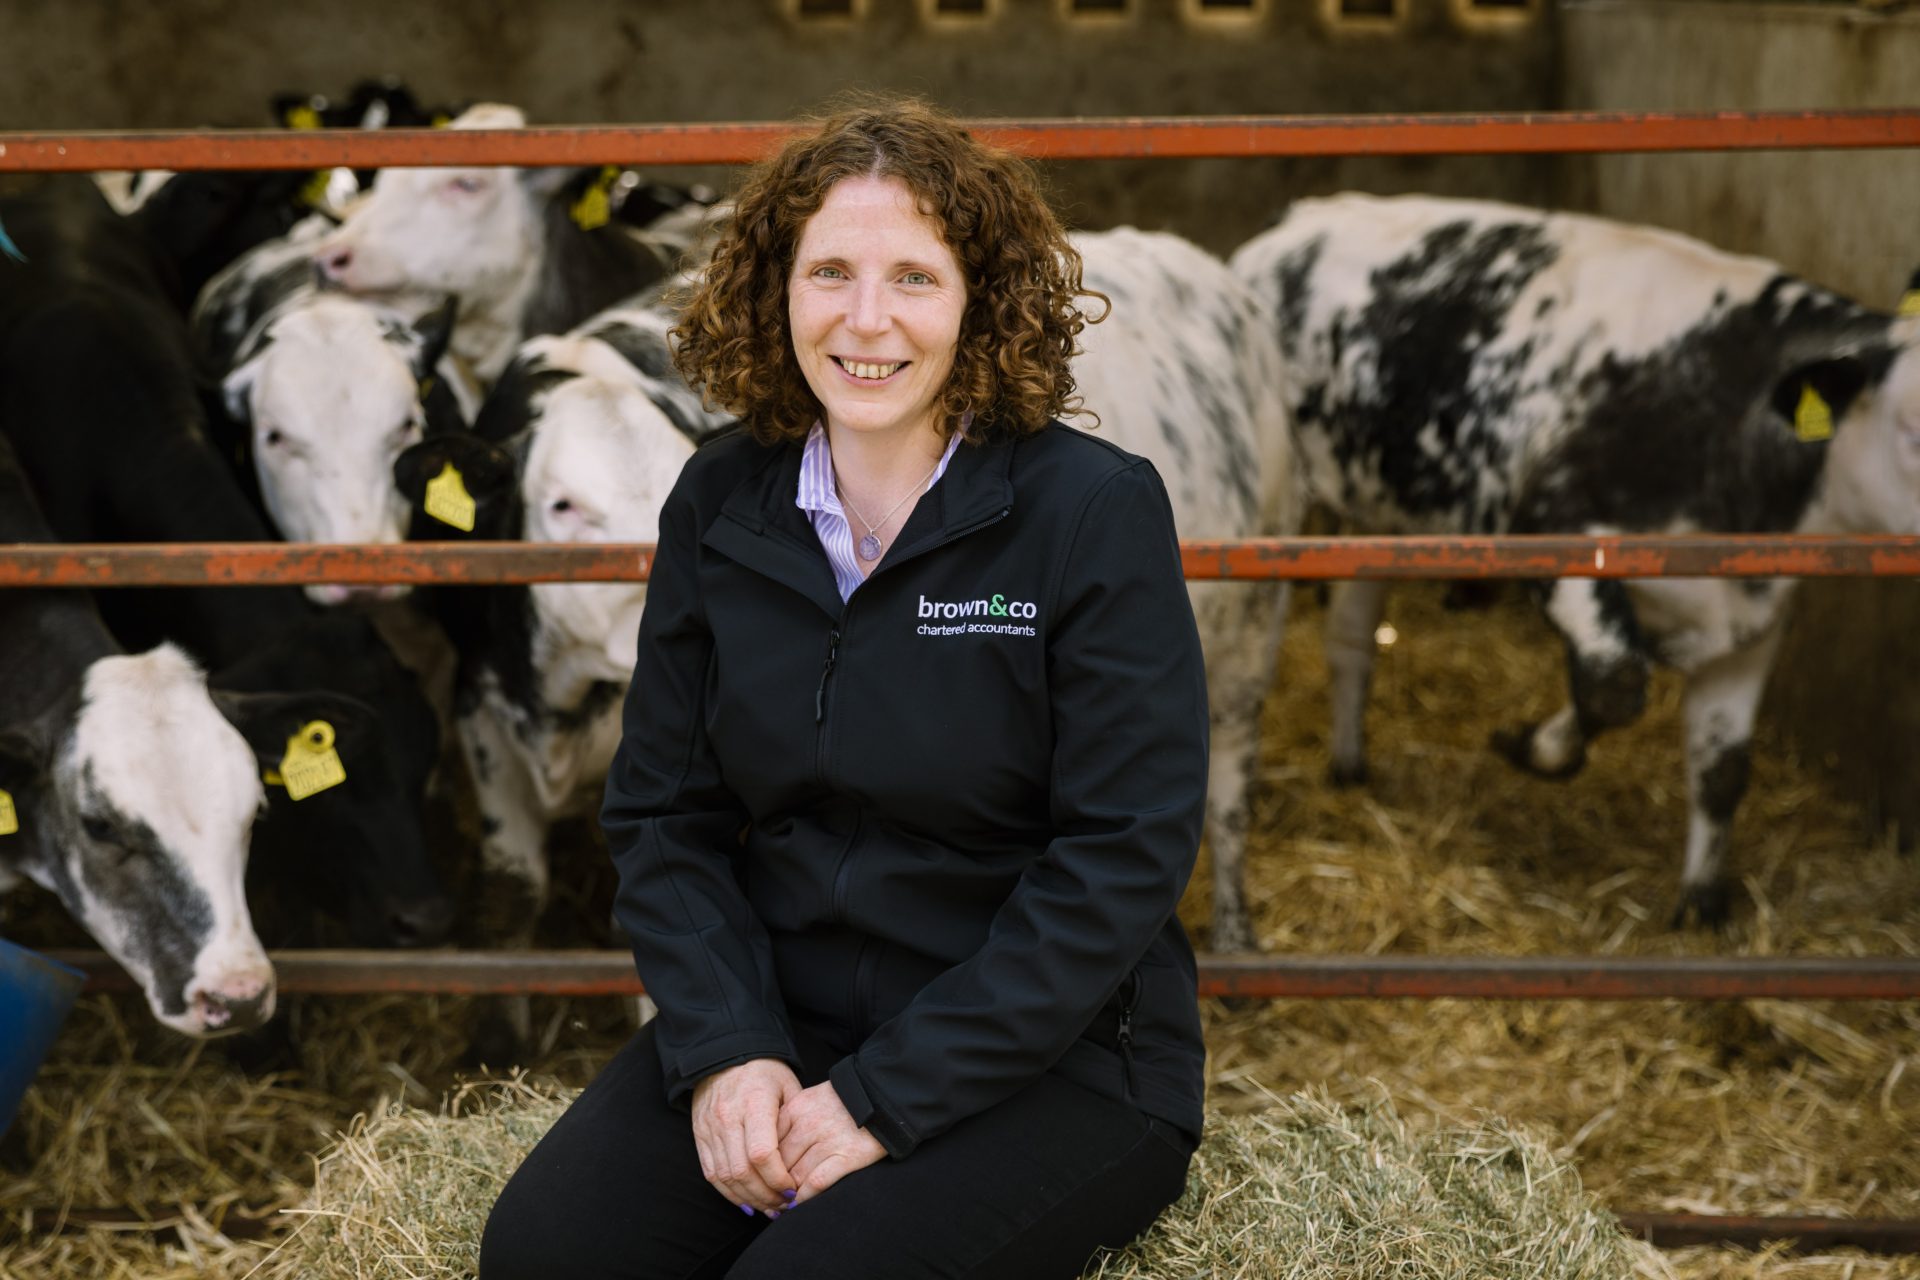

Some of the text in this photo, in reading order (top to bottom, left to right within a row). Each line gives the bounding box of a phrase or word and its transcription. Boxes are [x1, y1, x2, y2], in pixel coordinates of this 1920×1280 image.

[918, 594, 1037, 619] brown&co
[917, 622, 1036, 637] chartered accountants
